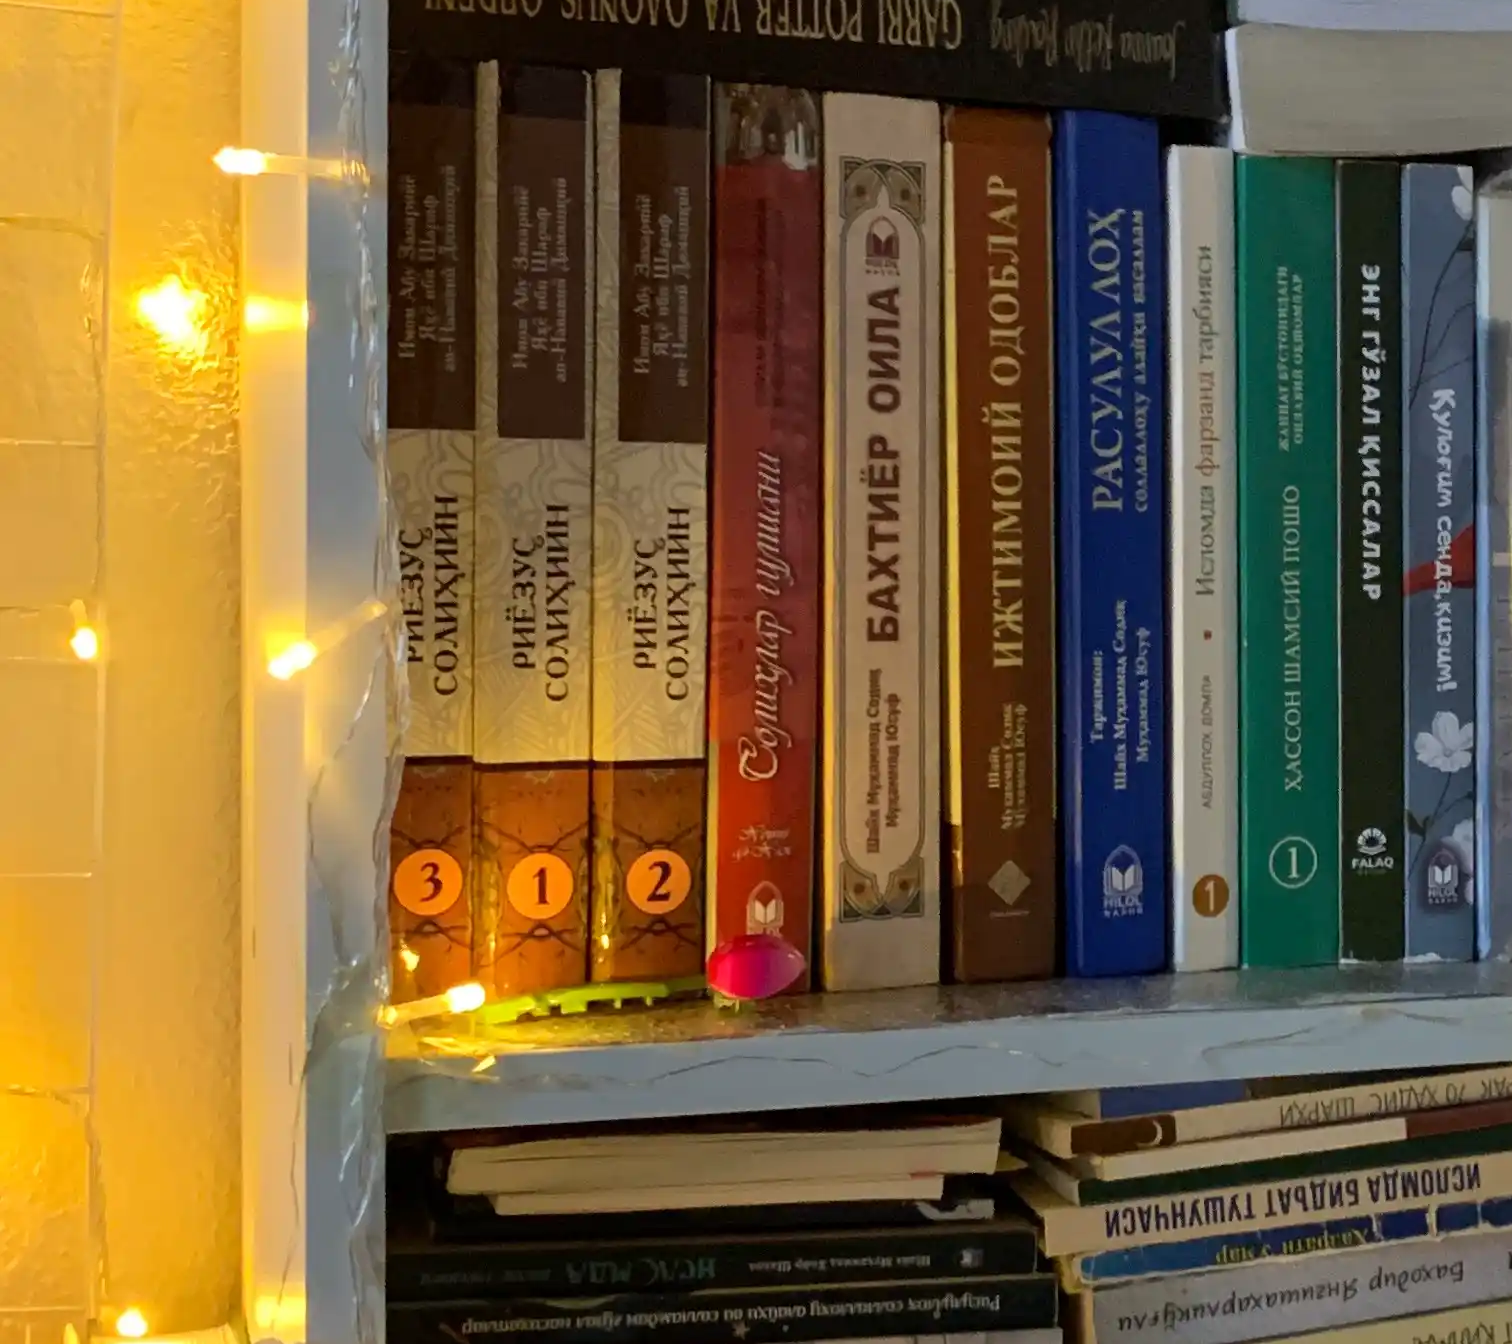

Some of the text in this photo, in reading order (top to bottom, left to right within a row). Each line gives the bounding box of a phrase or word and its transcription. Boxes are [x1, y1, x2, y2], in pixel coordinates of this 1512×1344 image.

[984, 174, 1027, 386] ОДОБЛАР
[858, 286, 901, 643] БАХТИЁР ОИЛА
[1192, 245, 1220, 596] Исломда фарзанд тарбияси
[1357, 264, 1388, 602] ЭНГ ГЎЗАЛ ҚИССАЛАР
[980, 402, 1026, 669] ИЖТИМОИЙ
[1279, 485, 1305, 791] ҲАССОН ШАМСИЙ ПОШО
[419, 862, 443, 903] 3
[534, 868, 548, 905] 1
[647, 861, 672, 901] 2
[1352, 857, 1394, 870] FALAQ
[1104, 1163, 1480, 1239] ИСЛОМДА БИДЪАТ ТУШУНЧАСИ
